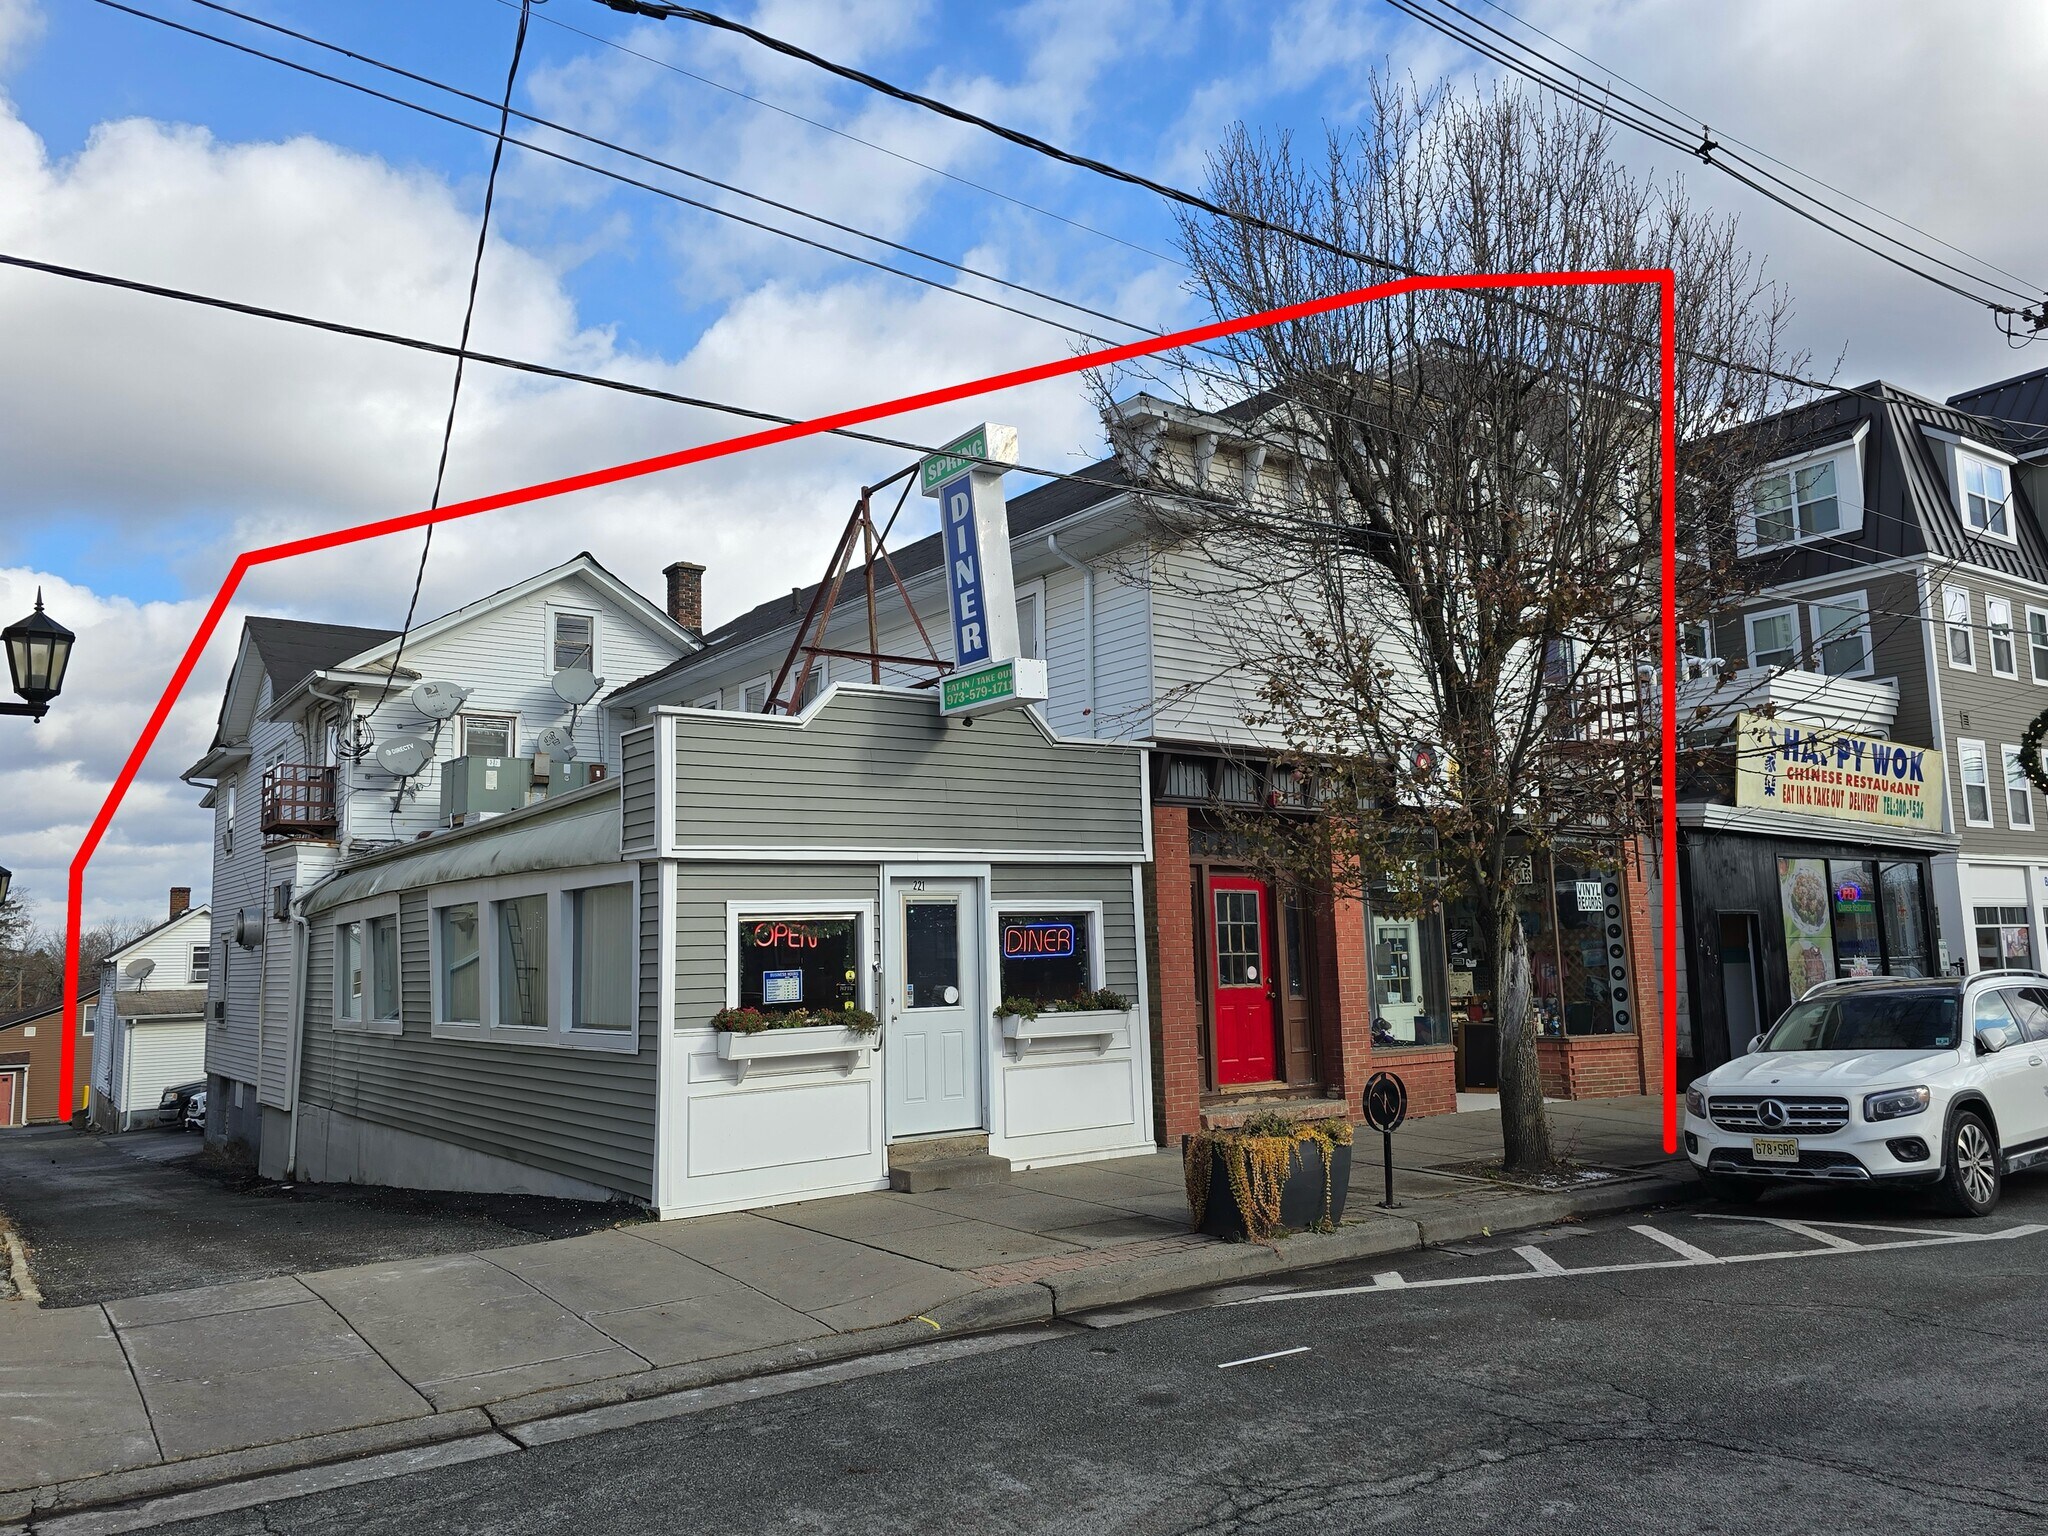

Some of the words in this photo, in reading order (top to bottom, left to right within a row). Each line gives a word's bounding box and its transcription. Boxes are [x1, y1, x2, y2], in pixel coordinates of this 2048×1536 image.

[950, 492, 983, 654] DINER
[946, 684, 960, 693] EAT
[976, 674, 996, 686] TAKE
[946, 681, 1013, 706] 973-579-1711
[391, 743, 415, 755] DIRECTV
[1871, 742, 1924, 783] WOK
[1787, 766, 1843, 785] CHINESE
[1846, 774, 1920, 797] RESTAURANT
[1782, 784, 1795, 804] EAT
[1796, 785, 1805, 805] IN
[1806, 785, 1812, 805] &
[1813, 786, 1830, 807] TAKE
[1831, 789, 1845, 808] OUT
[1849, 791, 1879, 813] DELIVERY
[913, 880, 925, 891] 221
[1577, 883, 1601, 896] VINYL
[1578, 896, 1602, 909] RECORDS
[1006, 928, 1071, 953] DINER
